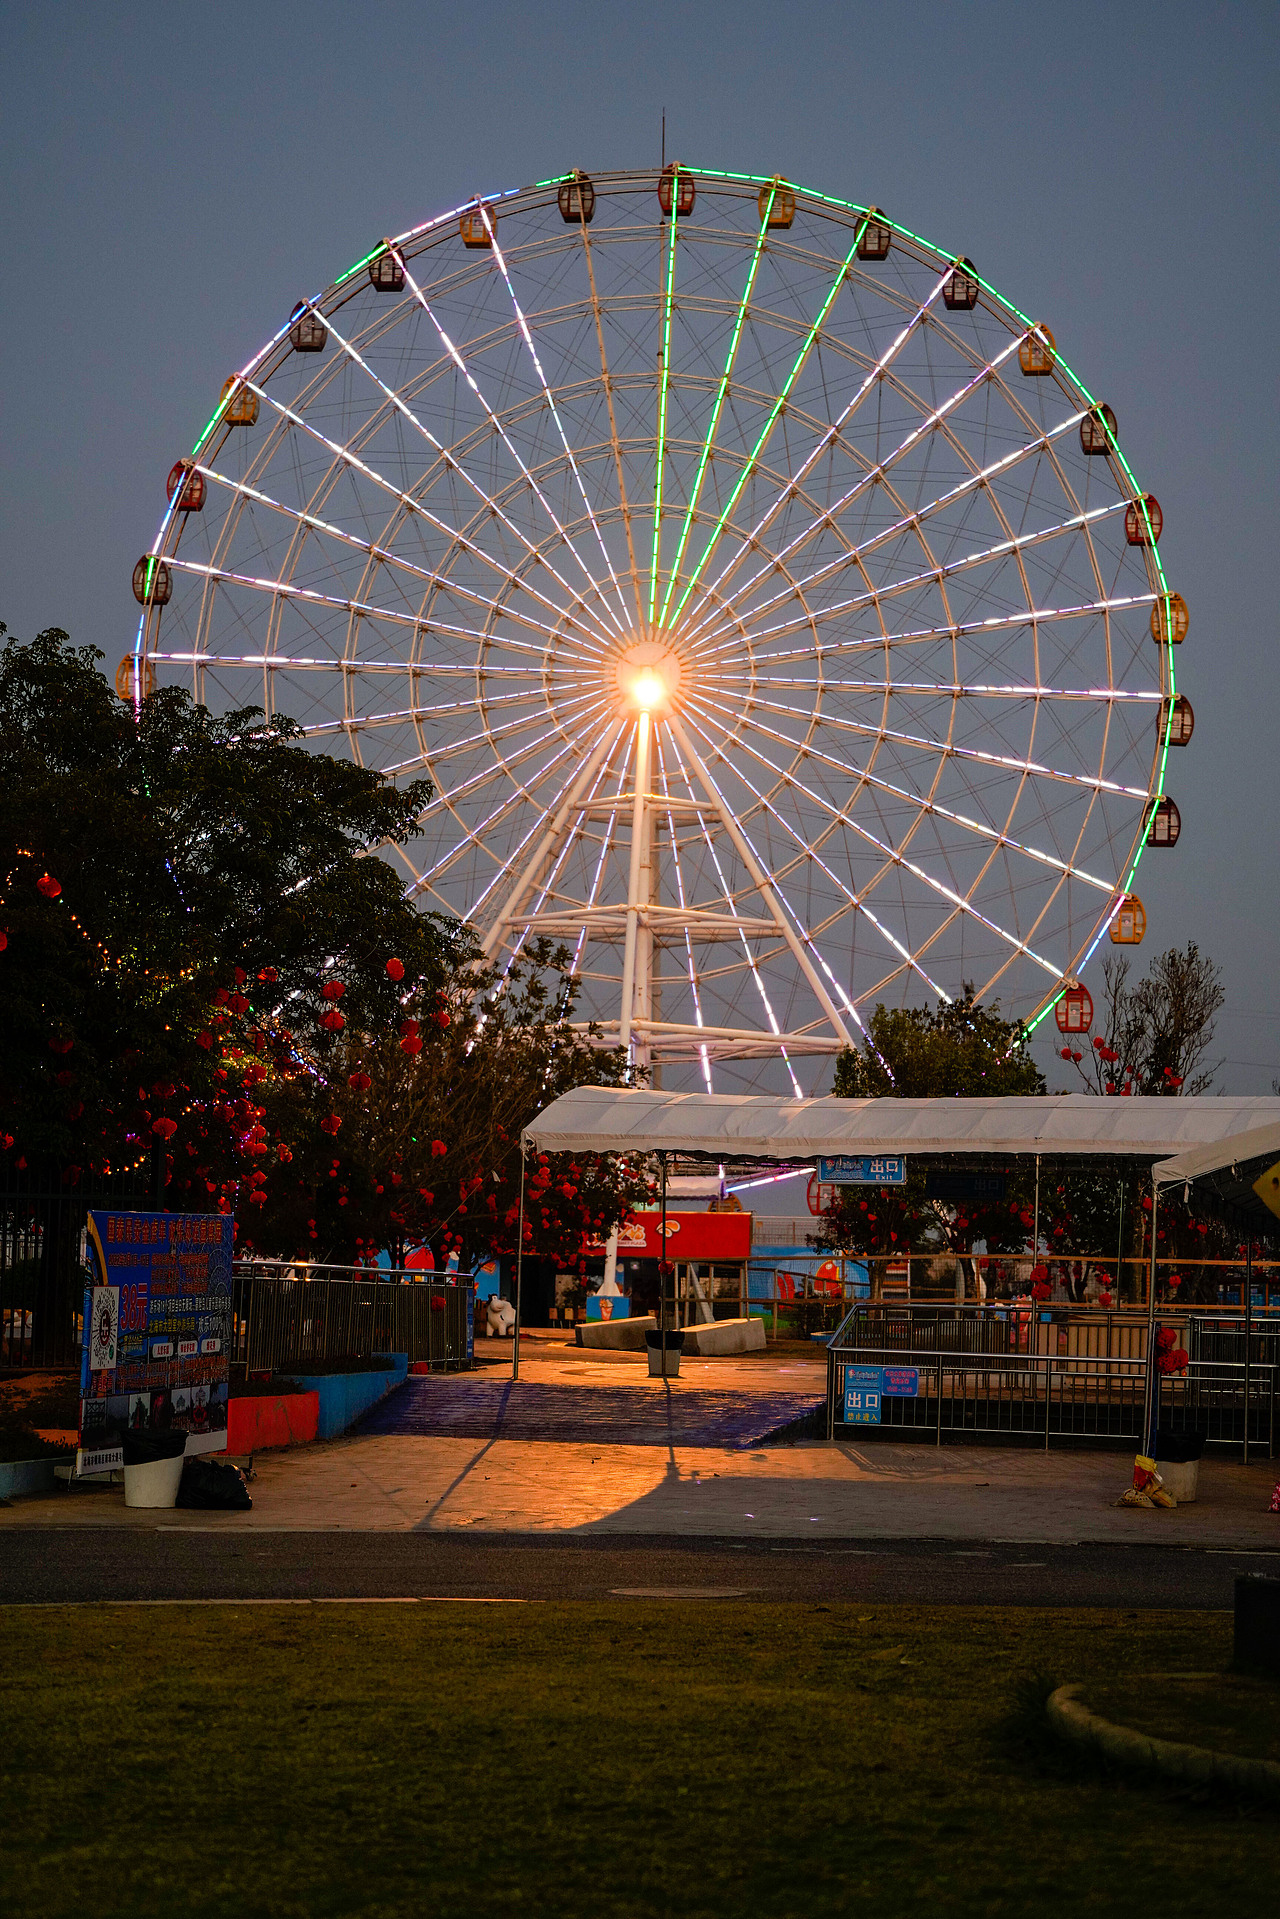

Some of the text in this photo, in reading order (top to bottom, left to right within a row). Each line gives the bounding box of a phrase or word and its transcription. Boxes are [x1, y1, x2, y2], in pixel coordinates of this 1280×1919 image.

[871, 1159, 899, 1173] 出口
[974, 1178, 999, 1191] 出口
[120, 1283, 148, 1331] 38元
[848, 1392, 878, 1408] 出口
